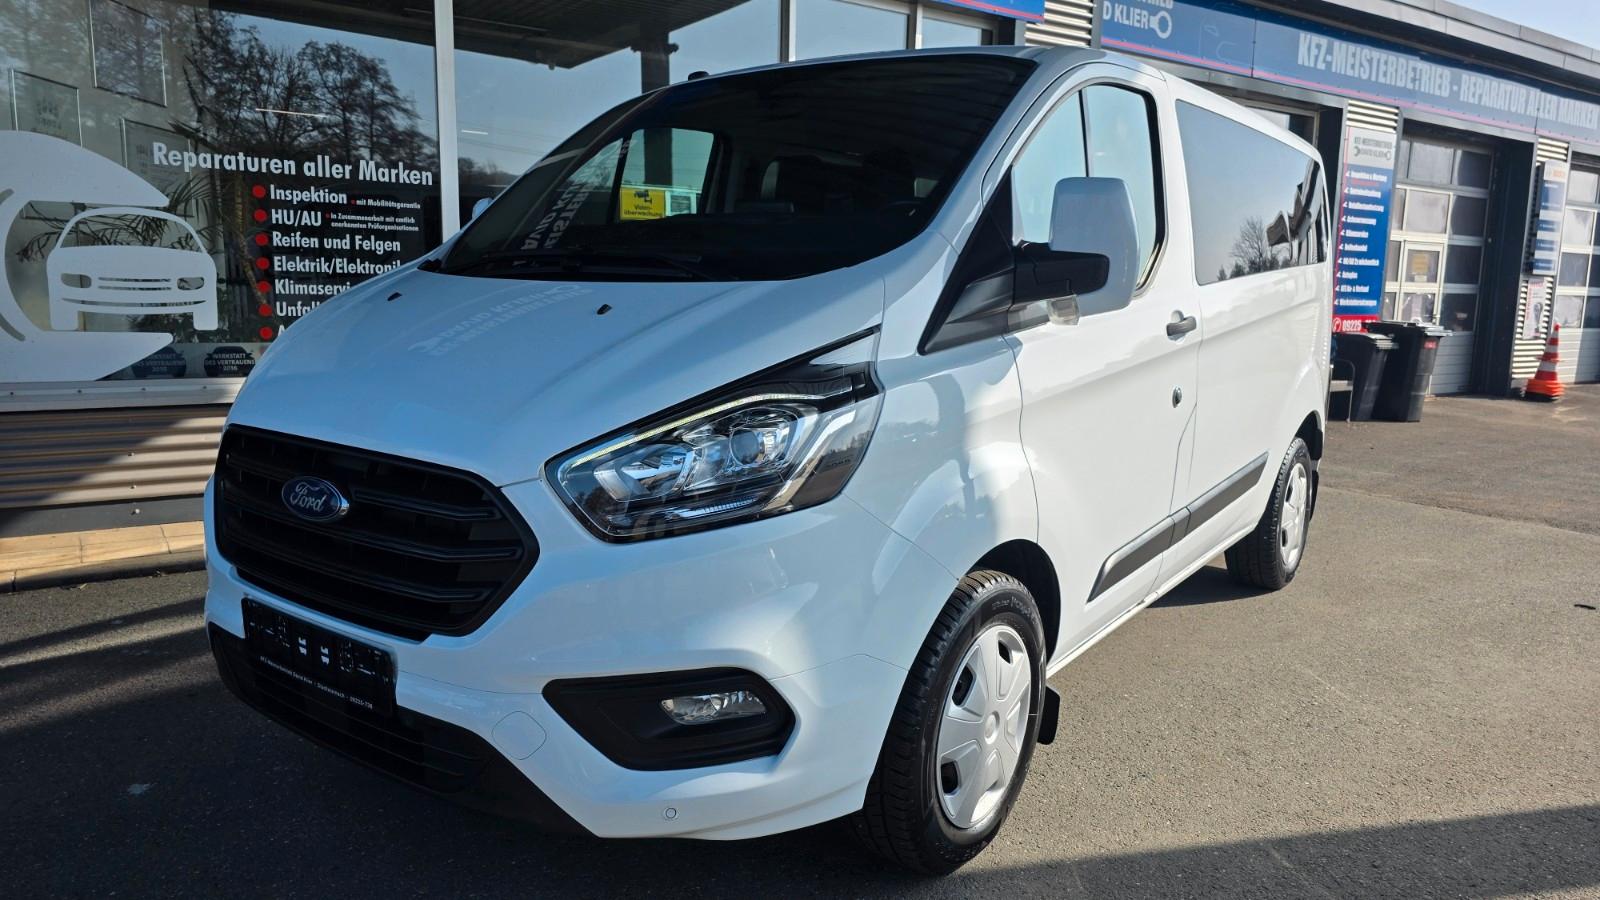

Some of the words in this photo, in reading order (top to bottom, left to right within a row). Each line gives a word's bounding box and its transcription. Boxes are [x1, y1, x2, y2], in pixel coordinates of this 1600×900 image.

[1114, 4, 1150, 30] KLIER
[1298, 32, 1450, 98] KFZ-MEISTERBETRIEB
[1460, 73, 1527, 115] REPARATUR
[1526, 89, 1557, 121] ALLER
[1558, 97, 1599, 131] MARKEN
[152, 142, 296, 175] Reparaturen
[303, 155, 352, 179] aller
[359, 160, 433, 186] Marken
[270, 184, 348, 205] Inspektion
[271, 208, 322, 228] HU/AU
[272, 231, 319, 249] Reifen
[324, 234, 350, 250] und
[355, 235, 401, 255] Felgen
[290, 481, 328, 512] Ford
